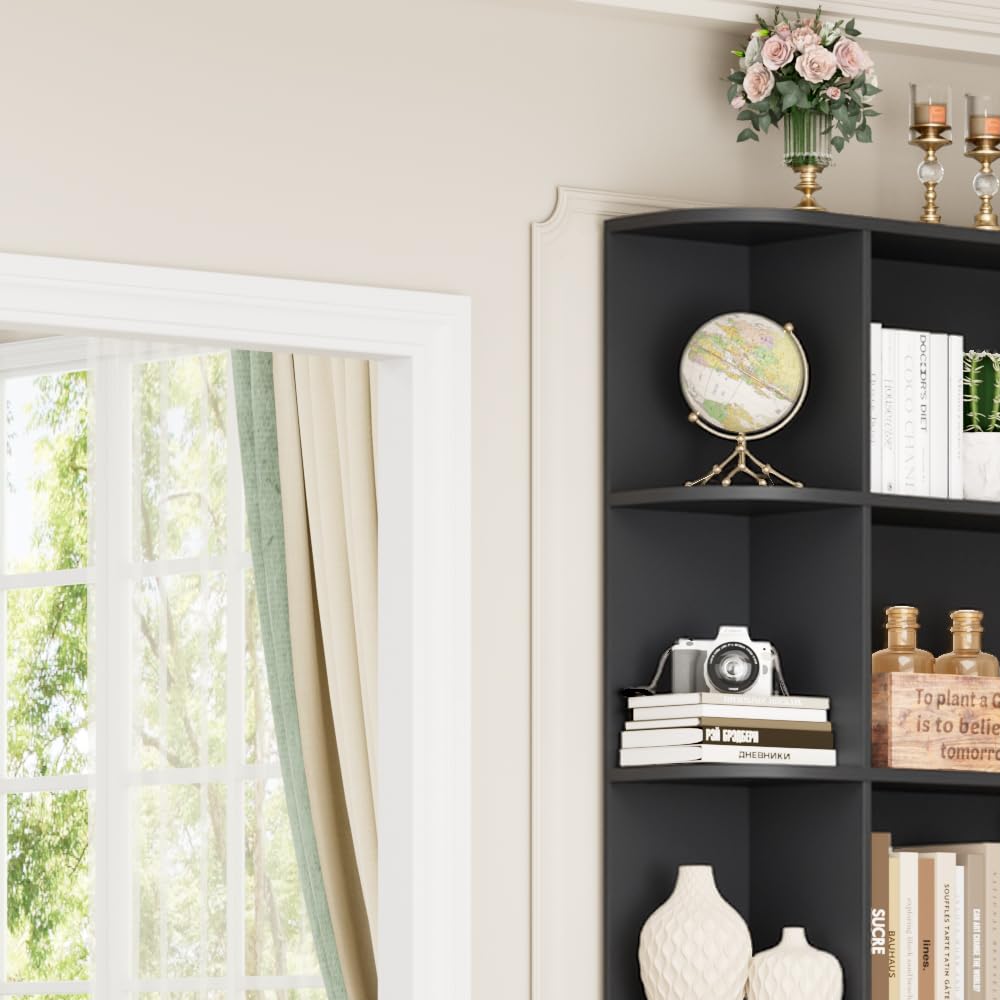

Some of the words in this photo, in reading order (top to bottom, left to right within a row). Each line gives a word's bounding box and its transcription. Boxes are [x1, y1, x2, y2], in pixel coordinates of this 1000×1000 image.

[919, 404, 929, 432] DIET
[915, 688, 933, 705] To
[936, 688, 976, 710] plant
[980, 695, 988, 708] a
[917, 714, 930, 733] is
[936, 717, 953, 734] to
[738, 750, 791, 761] ДНЕВНИКИ
[943, 884, 951, 923] SOUFFLÉS
[871, 908, 886, 955] SUCRE
[888, 930, 897, 978] BAUHAUS
[922, 939, 932, 971] lines.
